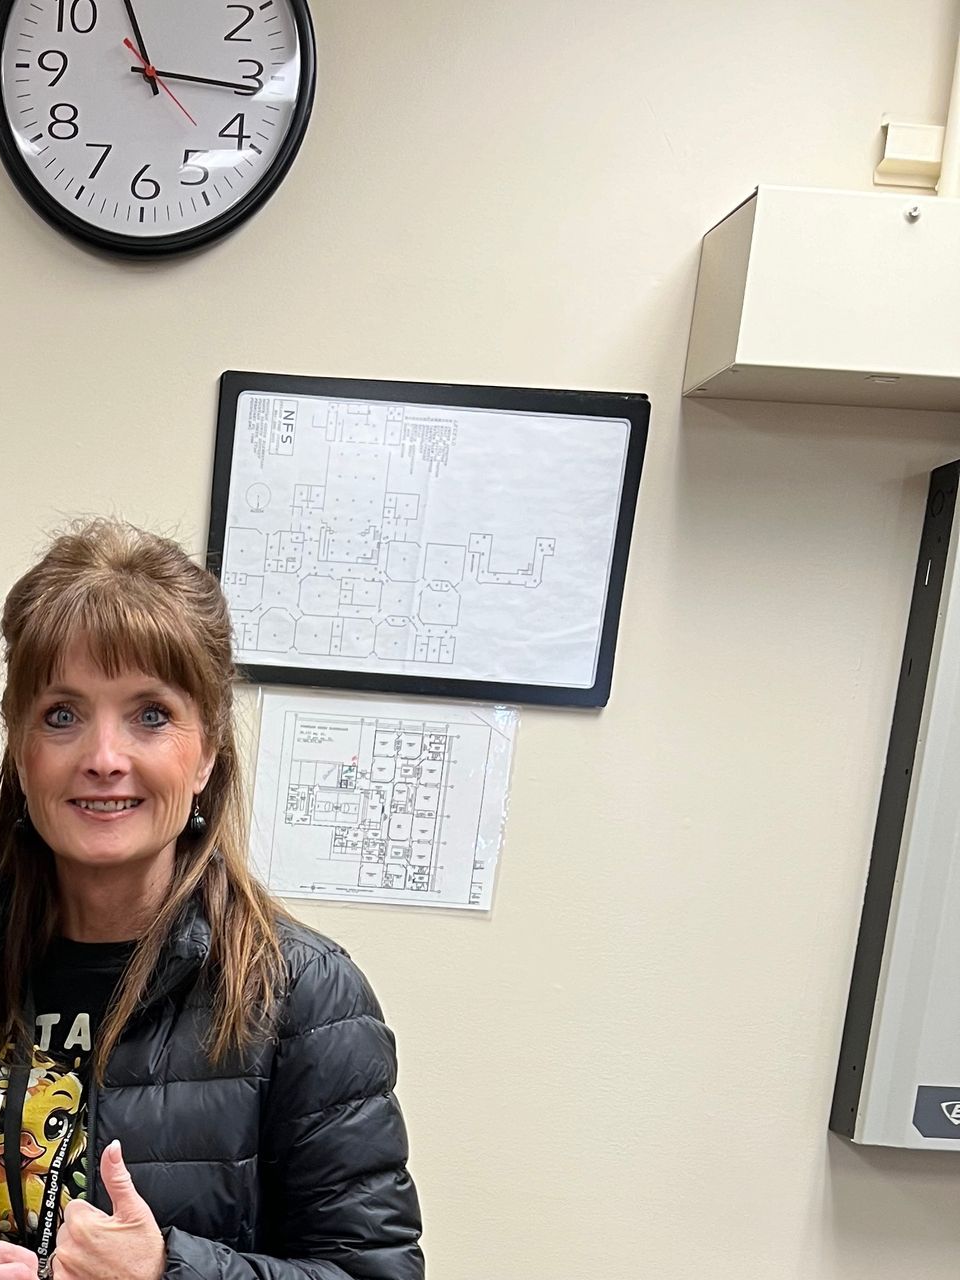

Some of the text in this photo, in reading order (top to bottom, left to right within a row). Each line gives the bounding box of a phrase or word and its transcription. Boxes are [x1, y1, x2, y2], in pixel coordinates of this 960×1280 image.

[55, 0, 98, 33] 10
[223, 4, 255, 42] 2
[37, 49, 68, 87] 9
[234, 58, 265, 96] 3
[47, 102, 79, 140] 8
[217, 111, 251, 151] 4
[85, 143, 113, 179] 7
[180, 149, 209, 186] 5
[130, 163, 161, 200] 6
[281, 409, 295, 444] NFS
[45, 1170, 59, 1209] School
[37, 1209, 54, 1256] Sanpete
